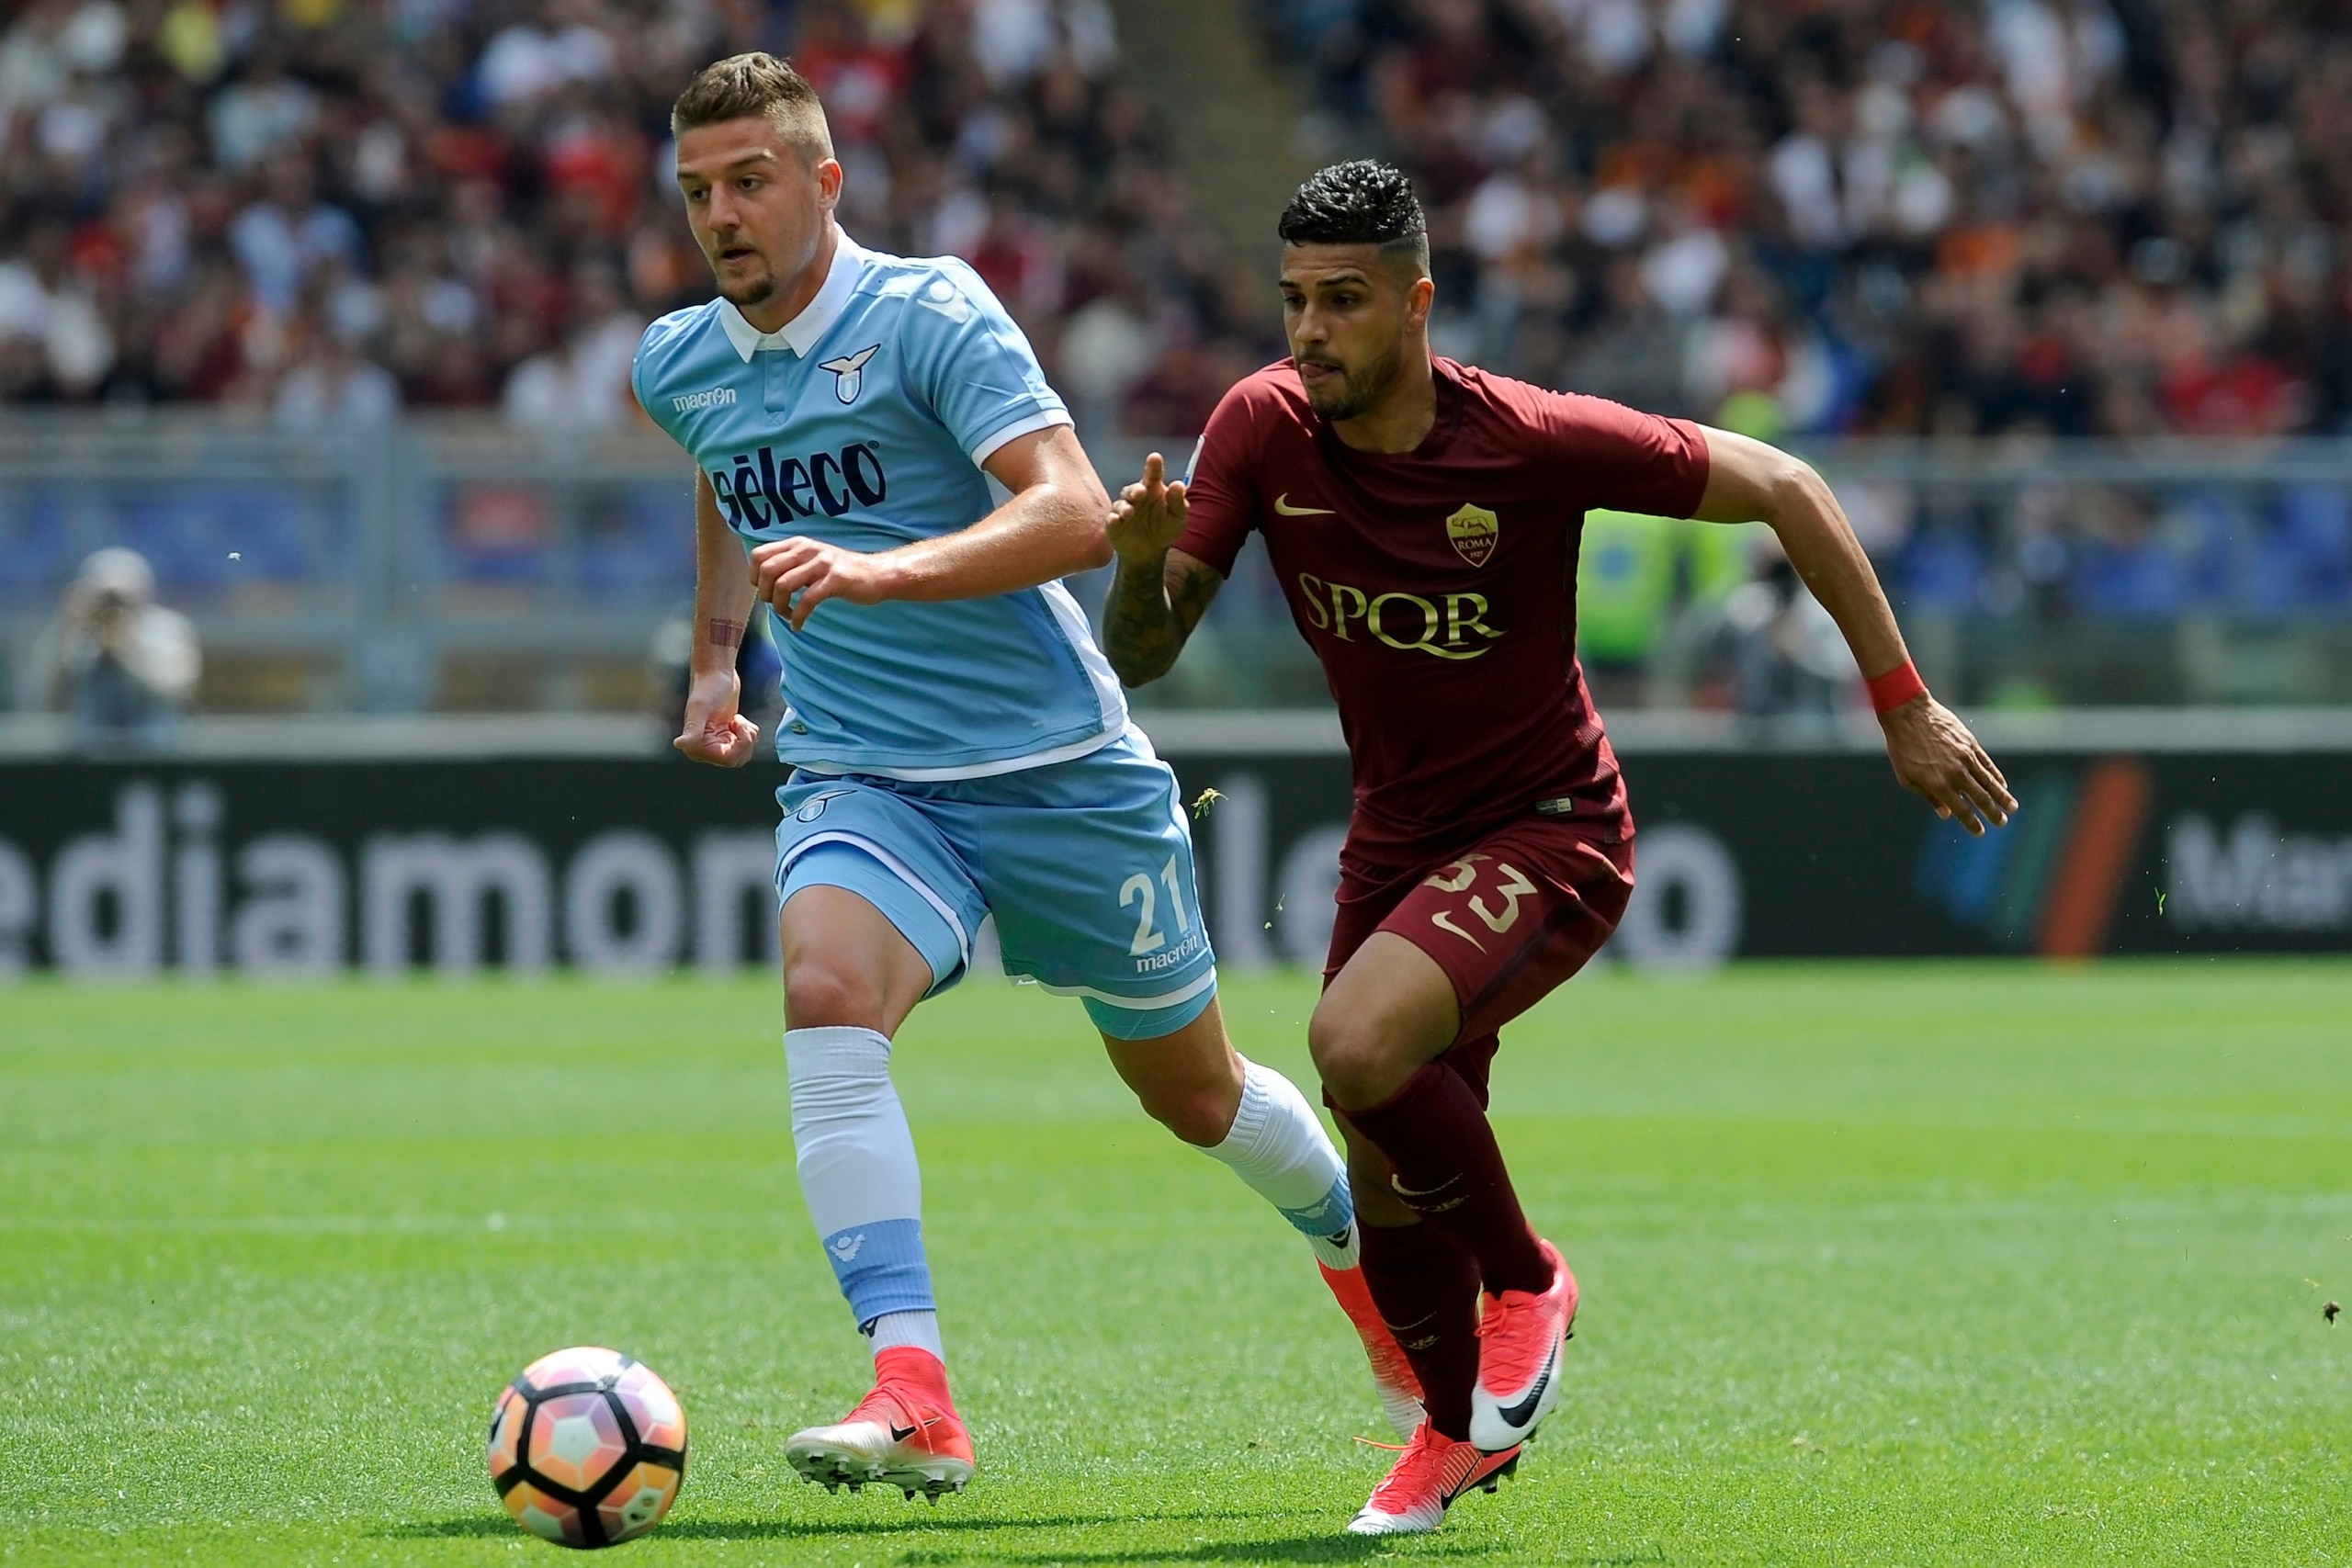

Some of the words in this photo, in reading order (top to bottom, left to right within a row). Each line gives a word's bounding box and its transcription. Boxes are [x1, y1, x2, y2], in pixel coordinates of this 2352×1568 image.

[672, 387, 737, 412] macron
[1457, 537, 1493, 550] ROMA
[1298, 572, 1509, 660] SPQR
[1119, 852, 1189, 956] 21
[1136, 934, 1198, 973] macron
